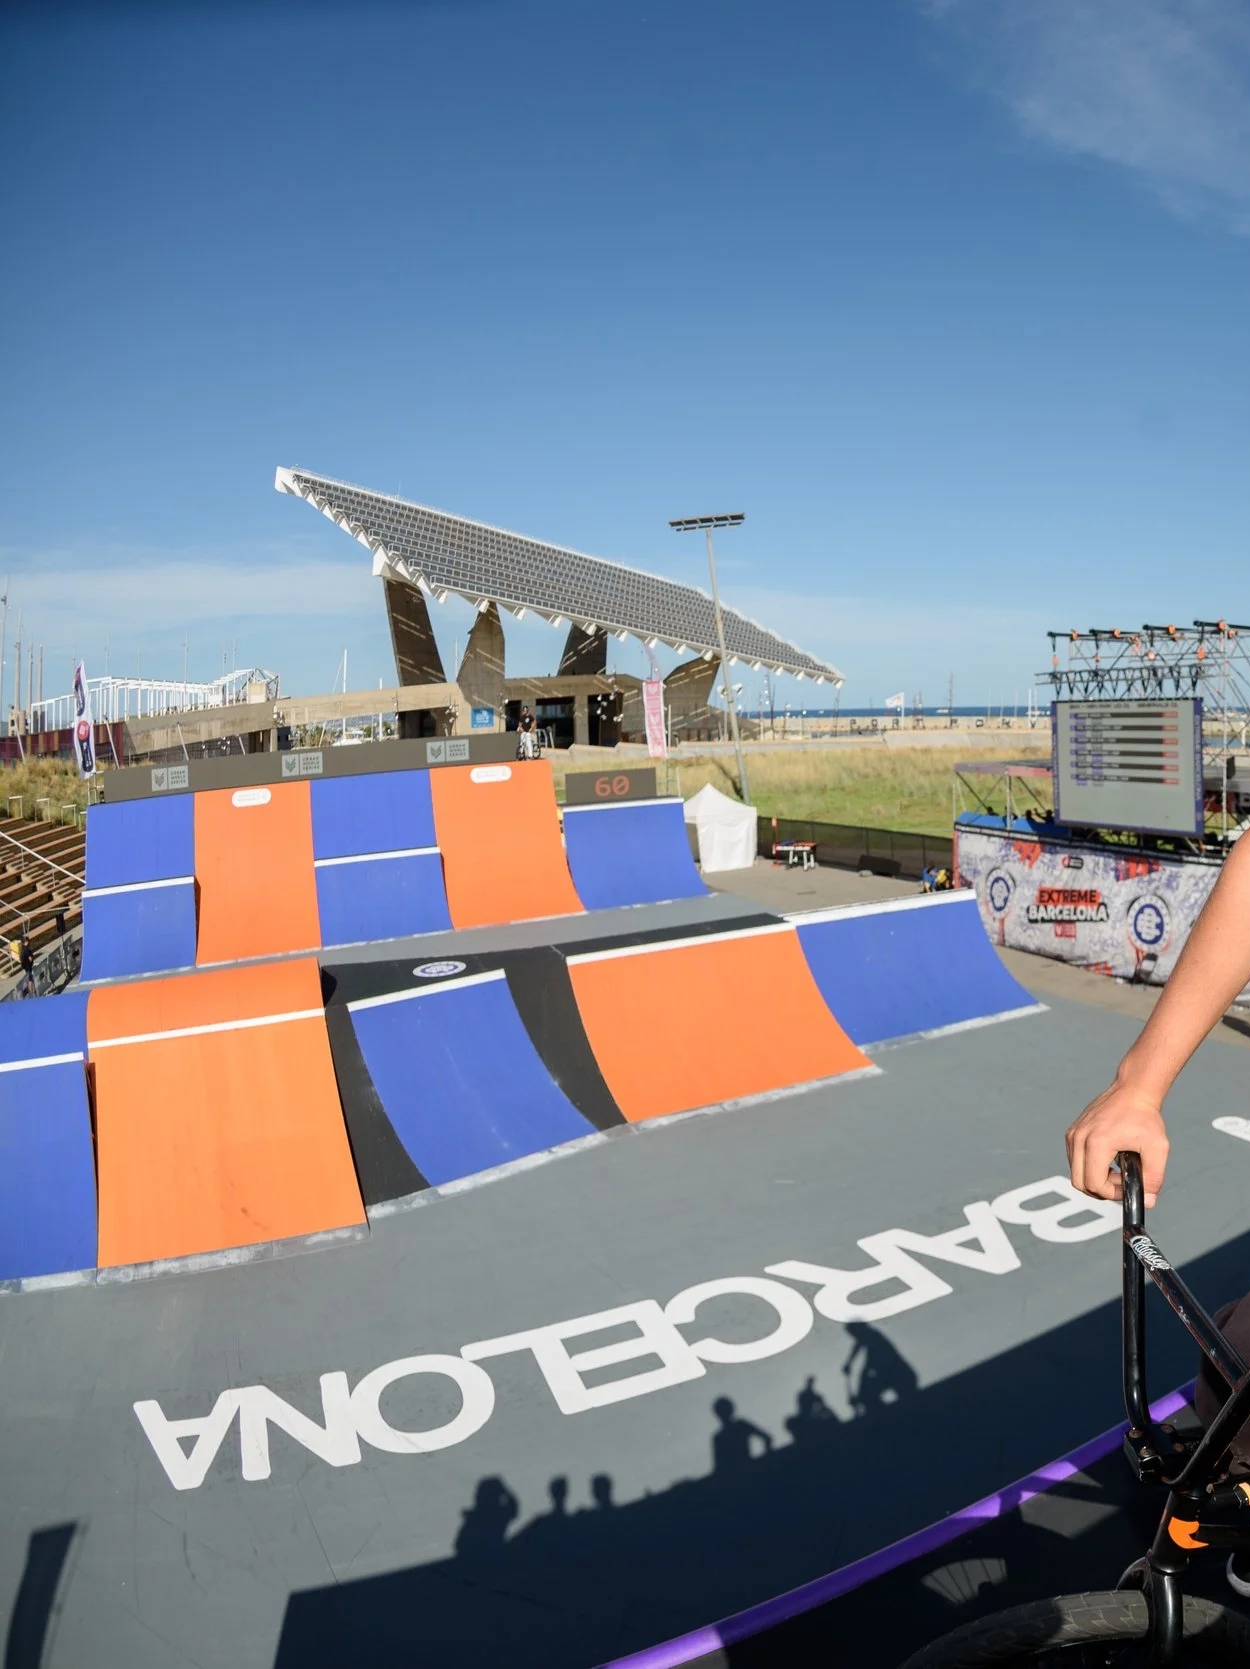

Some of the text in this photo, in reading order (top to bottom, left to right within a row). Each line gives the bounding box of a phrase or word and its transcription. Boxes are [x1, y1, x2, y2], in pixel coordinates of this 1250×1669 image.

[594, 775, 630, 797] 60
[1038, 889, 1098, 904] EXTREME
[1028, 903, 1108, 922] BARCELONA
[133, 1174, 1125, 1491] BARCELONA
